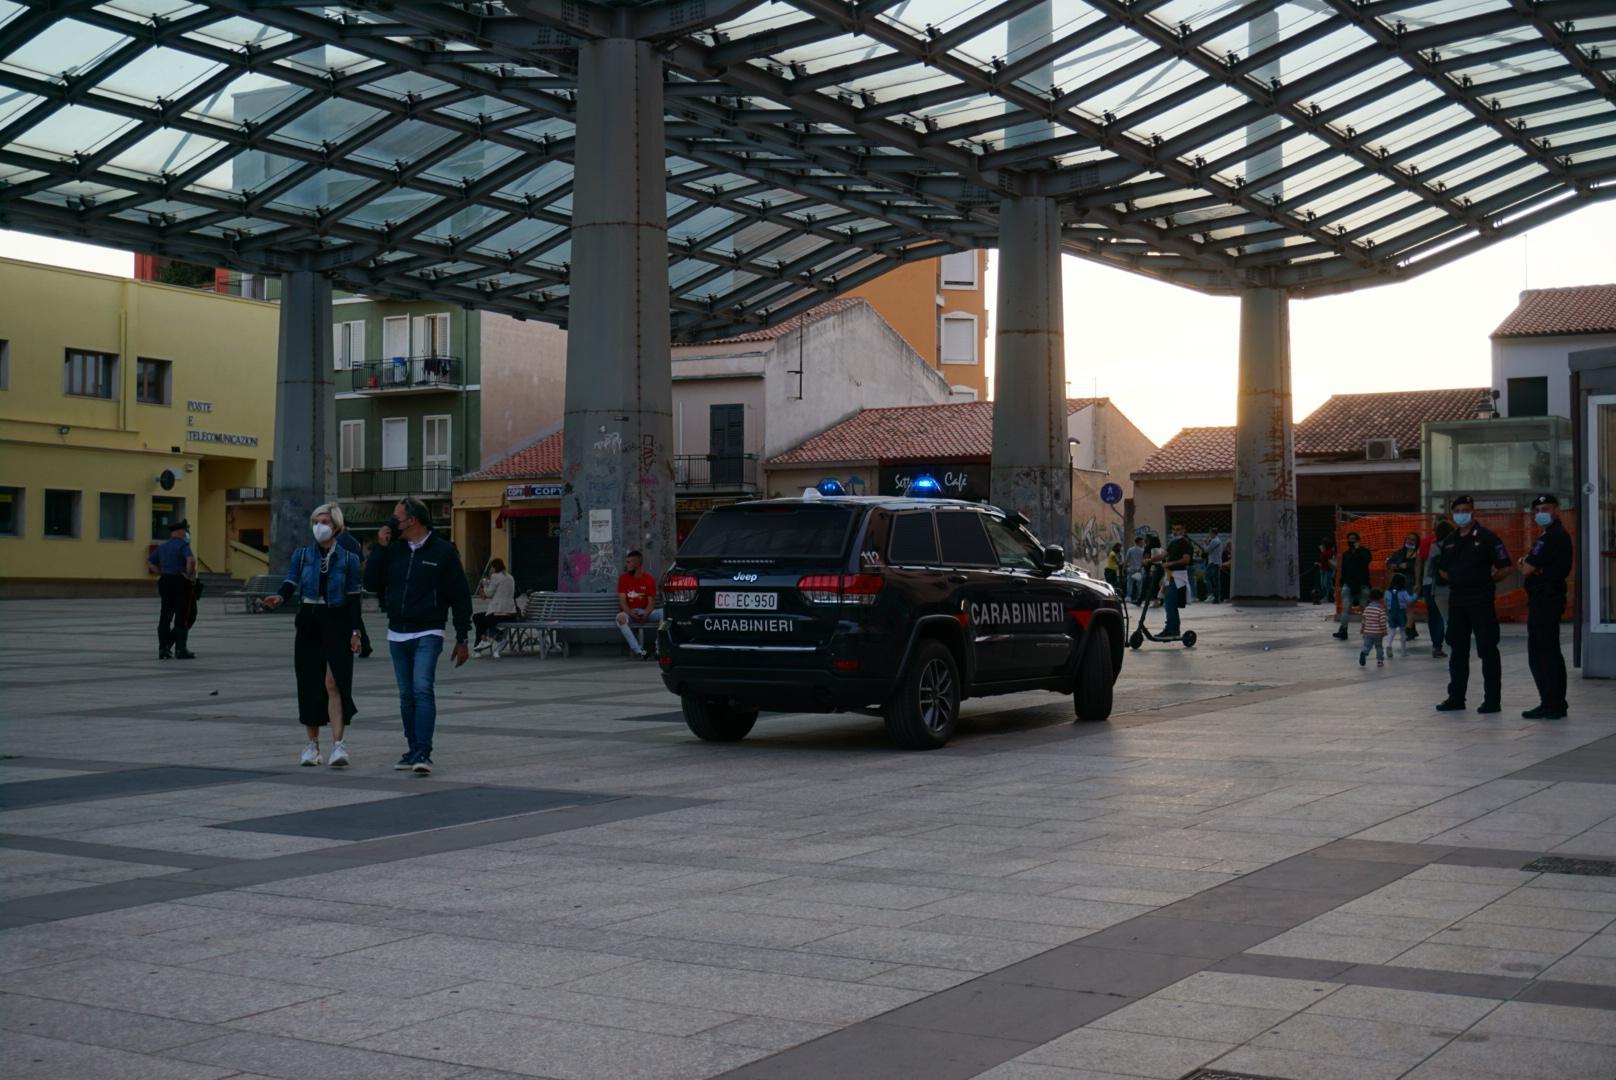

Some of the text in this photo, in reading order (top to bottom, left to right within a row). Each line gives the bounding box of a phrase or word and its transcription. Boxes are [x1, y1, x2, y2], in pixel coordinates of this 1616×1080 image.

[187, 400, 212, 413] POSTE
[187, 415, 193, 427] E
[860, 551, 881, 565] 112
[733, 571, 758, 582] Jeep
[717, 593, 730, 607] CC
[970, 602, 1065, 625] CARABINIERI
[704, 618, 793, 632] CARABINIERI
